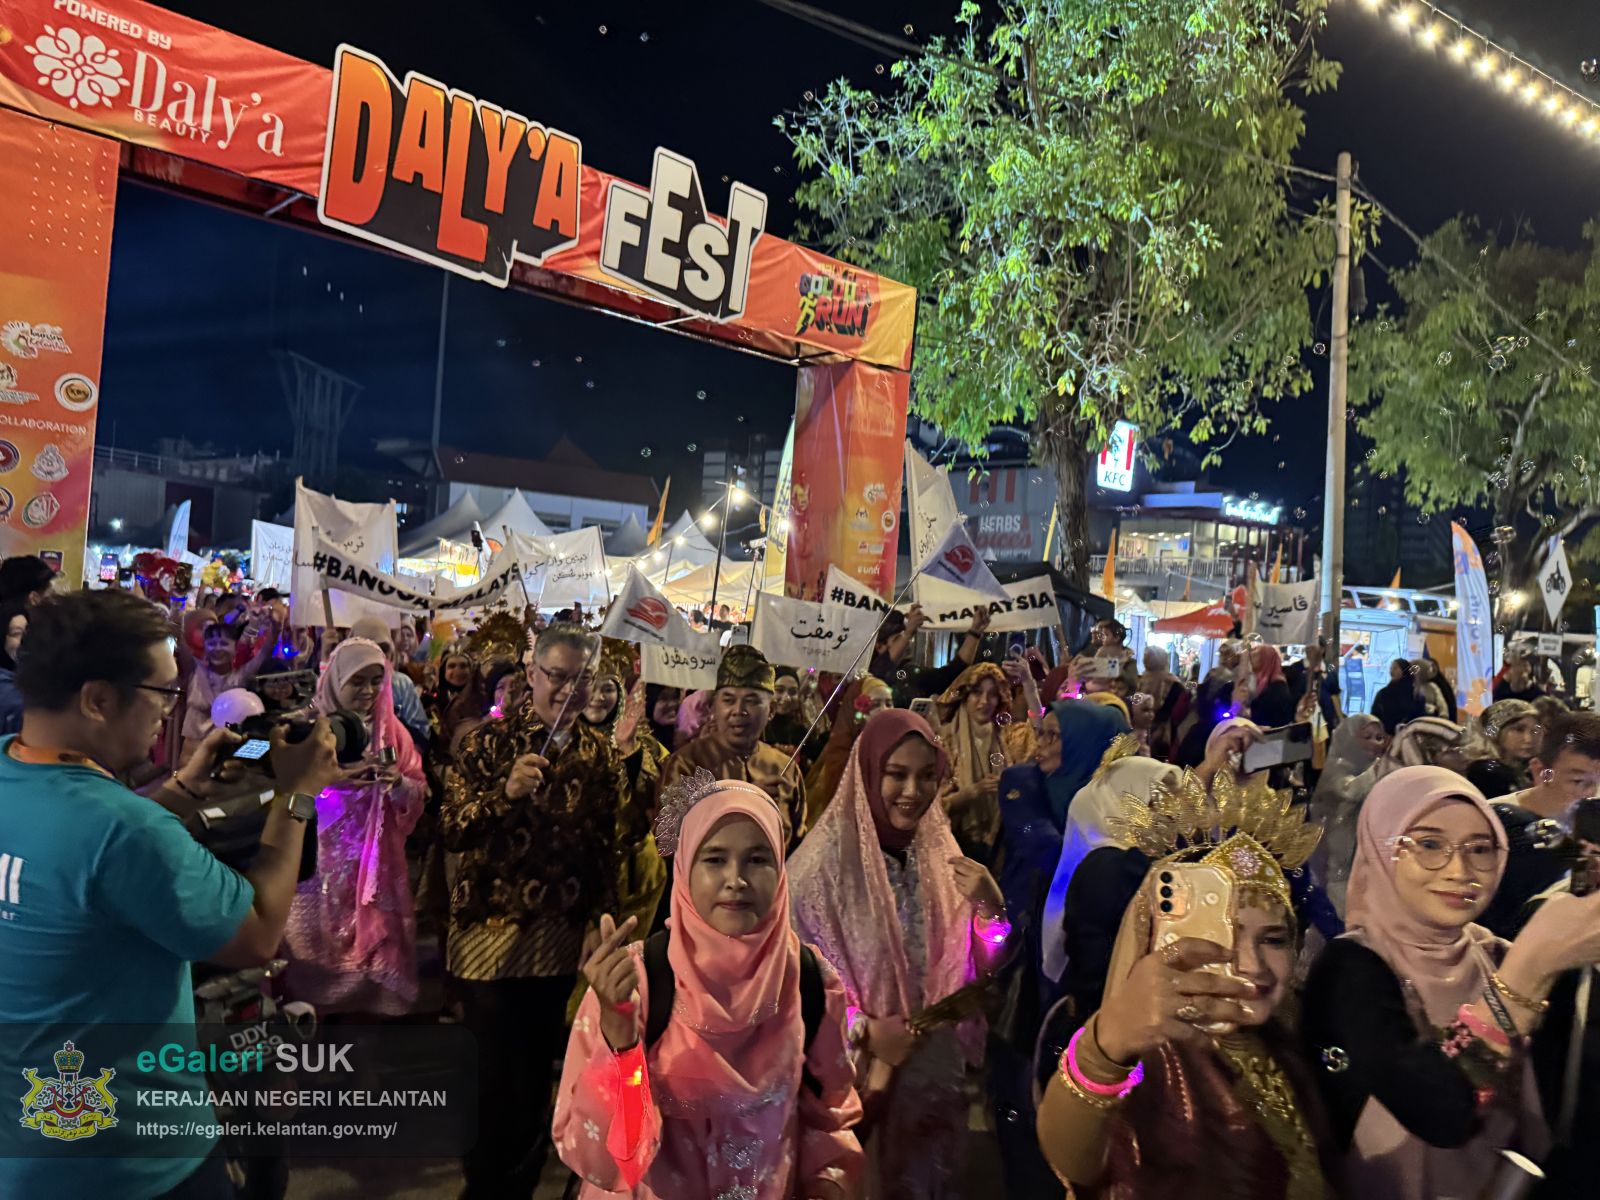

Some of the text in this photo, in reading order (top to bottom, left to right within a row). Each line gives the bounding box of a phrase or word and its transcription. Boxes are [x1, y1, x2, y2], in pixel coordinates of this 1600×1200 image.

[53, 0, 173, 50] POWERED BY
[128, 48, 284, 157] Daly'a
[134, 108, 213, 144] BEAUTY
[324, 50, 766, 315] DALY'A FEST
[814, 296, 869, 336] RUN
[1104, 471, 1126, 486] KFC
[980, 514, 1021, 533] HERBS
